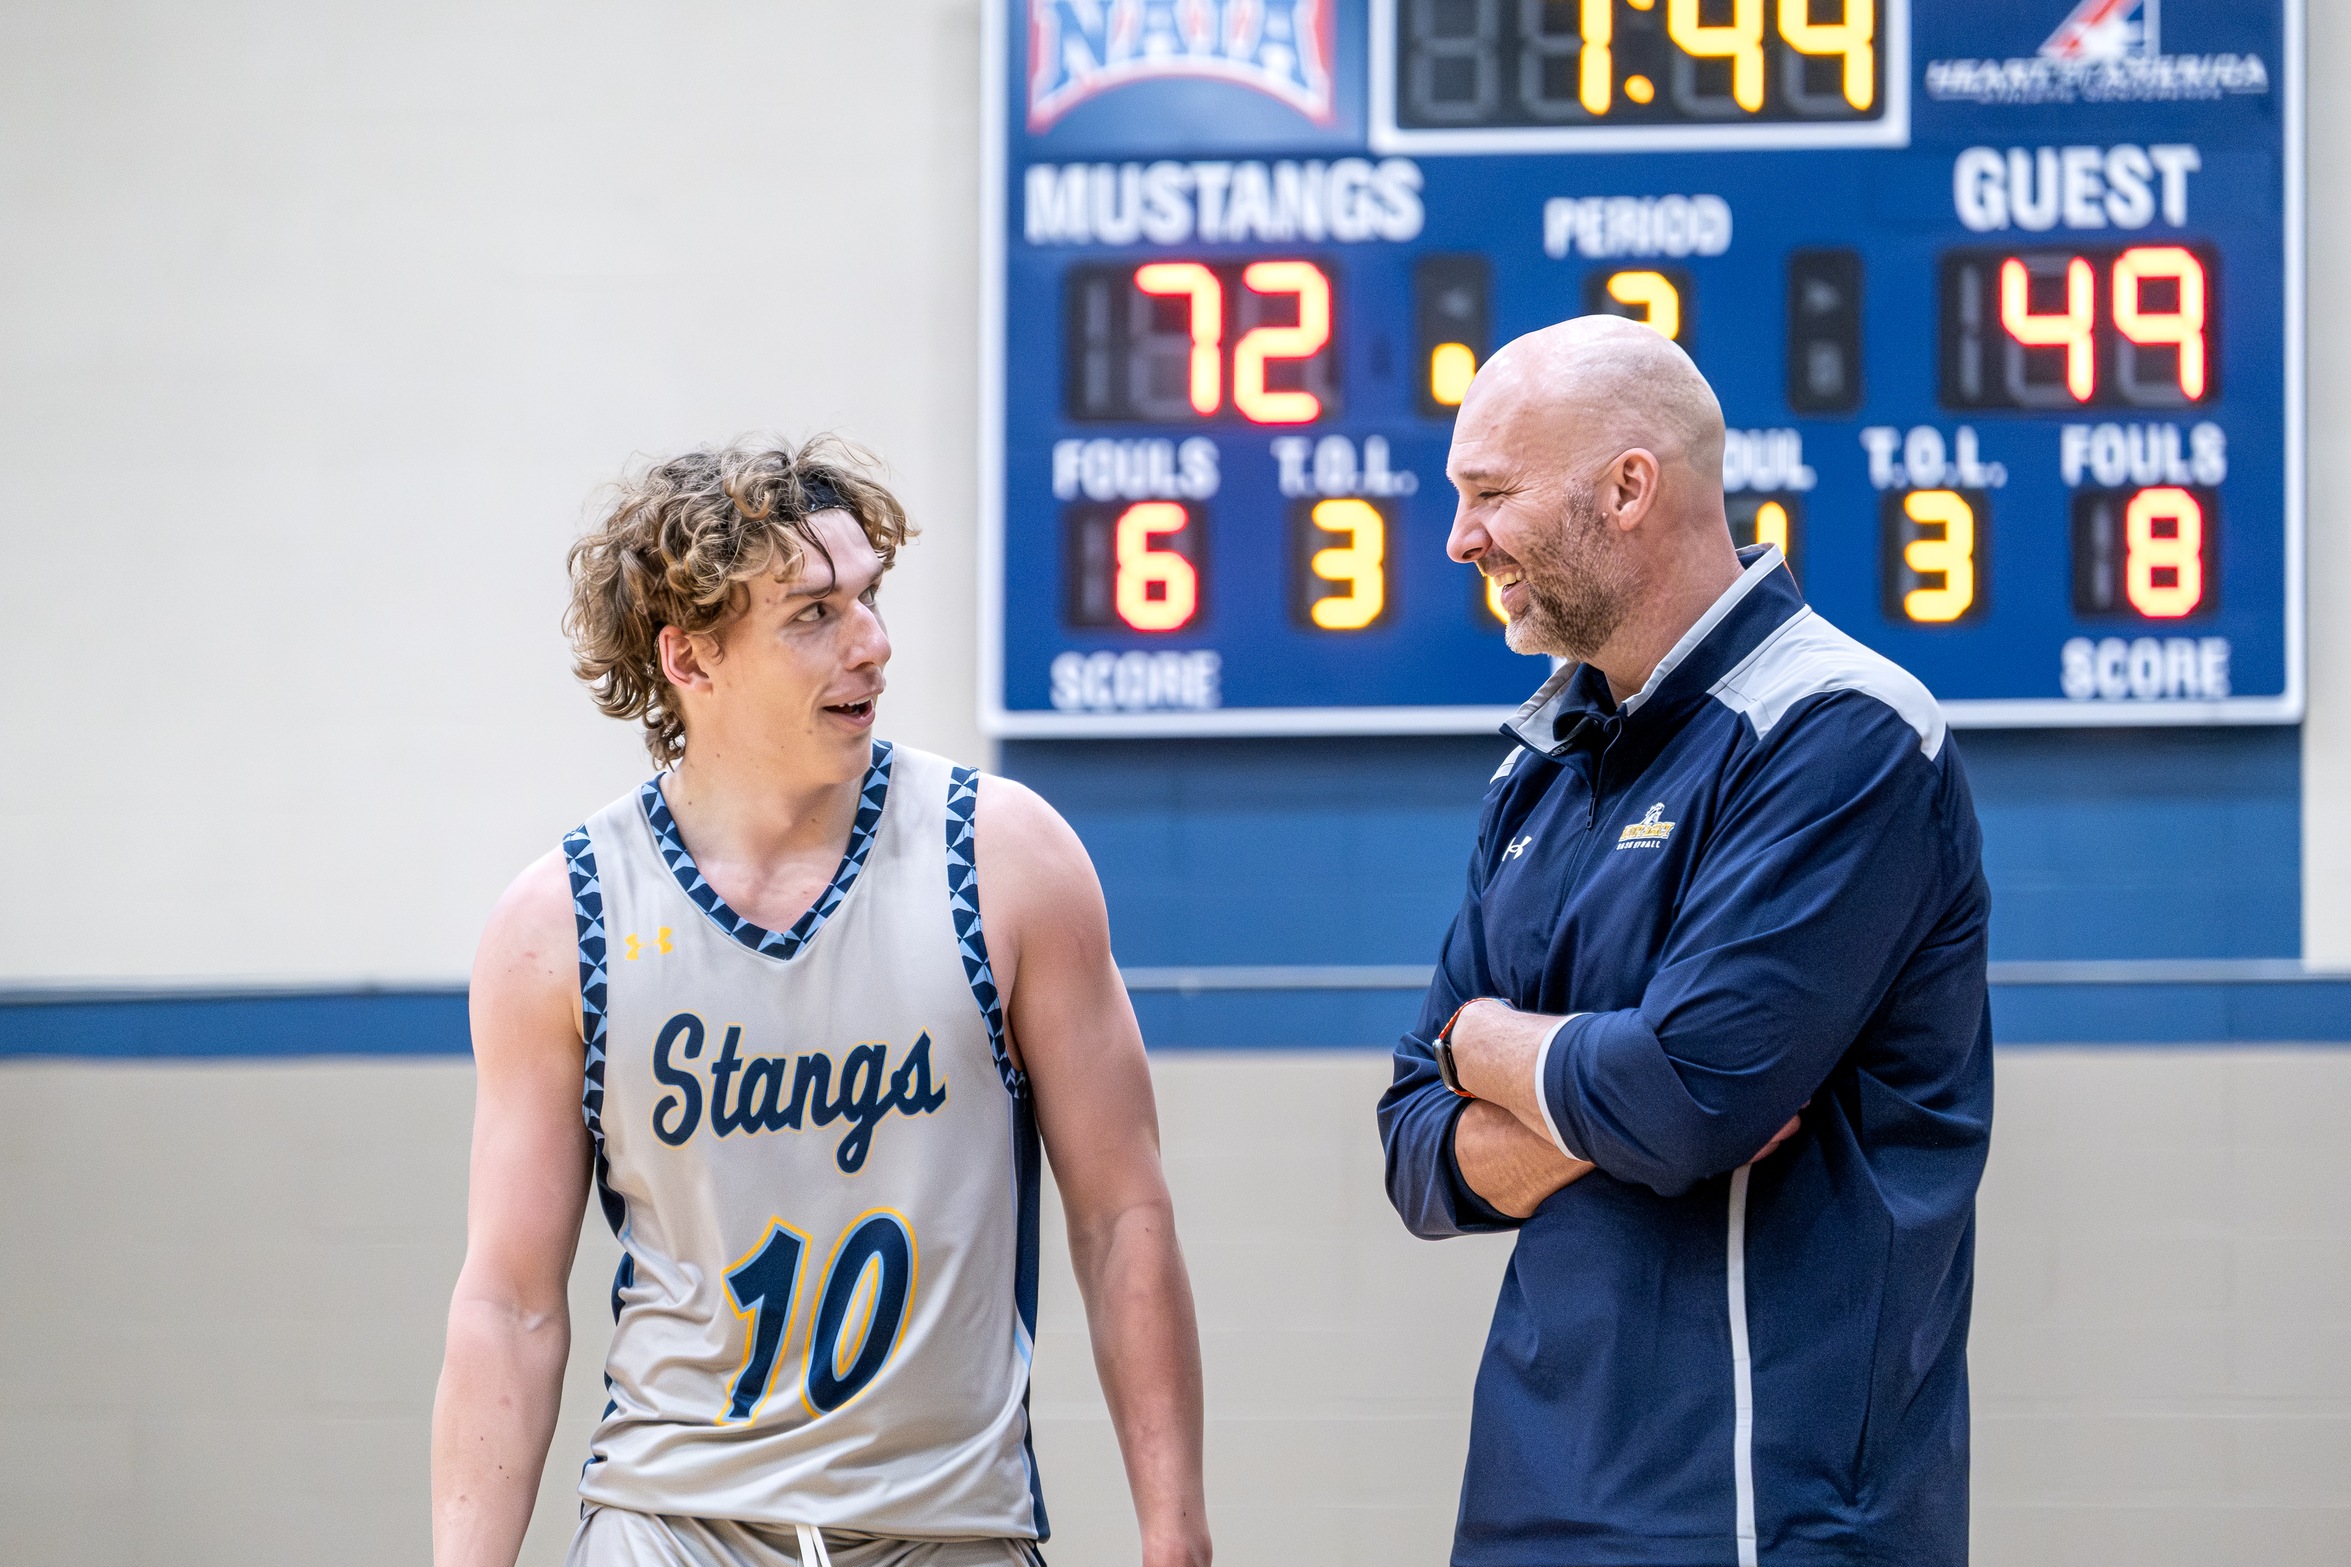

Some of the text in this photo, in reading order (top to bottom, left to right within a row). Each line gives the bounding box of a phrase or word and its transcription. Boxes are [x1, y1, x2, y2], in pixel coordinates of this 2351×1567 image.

[1025, 157, 1425, 245] MUSTANGS
[1543, 194, 1733, 260] PERIOD
[1953, 145, 2200, 232] GUEST
[1134, 261, 1330, 424] 72
[2000, 246, 2204, 403] 49
[1052, 437, 1221, 501] FOULS
[1270, 434, 1419, 498] T.O.L.
[1722, 427, 1818, 493] OUL
[1859, 424, 2008, 490] T.O.L.
[2060, 421, 2227, 488] FOULS
[1116, 501, 1197, 632] 6
[1311, 498, 1384, 630] 3
[1904, 489, 1974, 622] 3
[2126, 485, 2202, 618] 8
[1050, 650, 1222, 710] SCORE
[2060, 636, 2232, 700] SCORE
[649, 1010, 949, 1177] Stangs
[715, 1206, 919, 1427] 10
